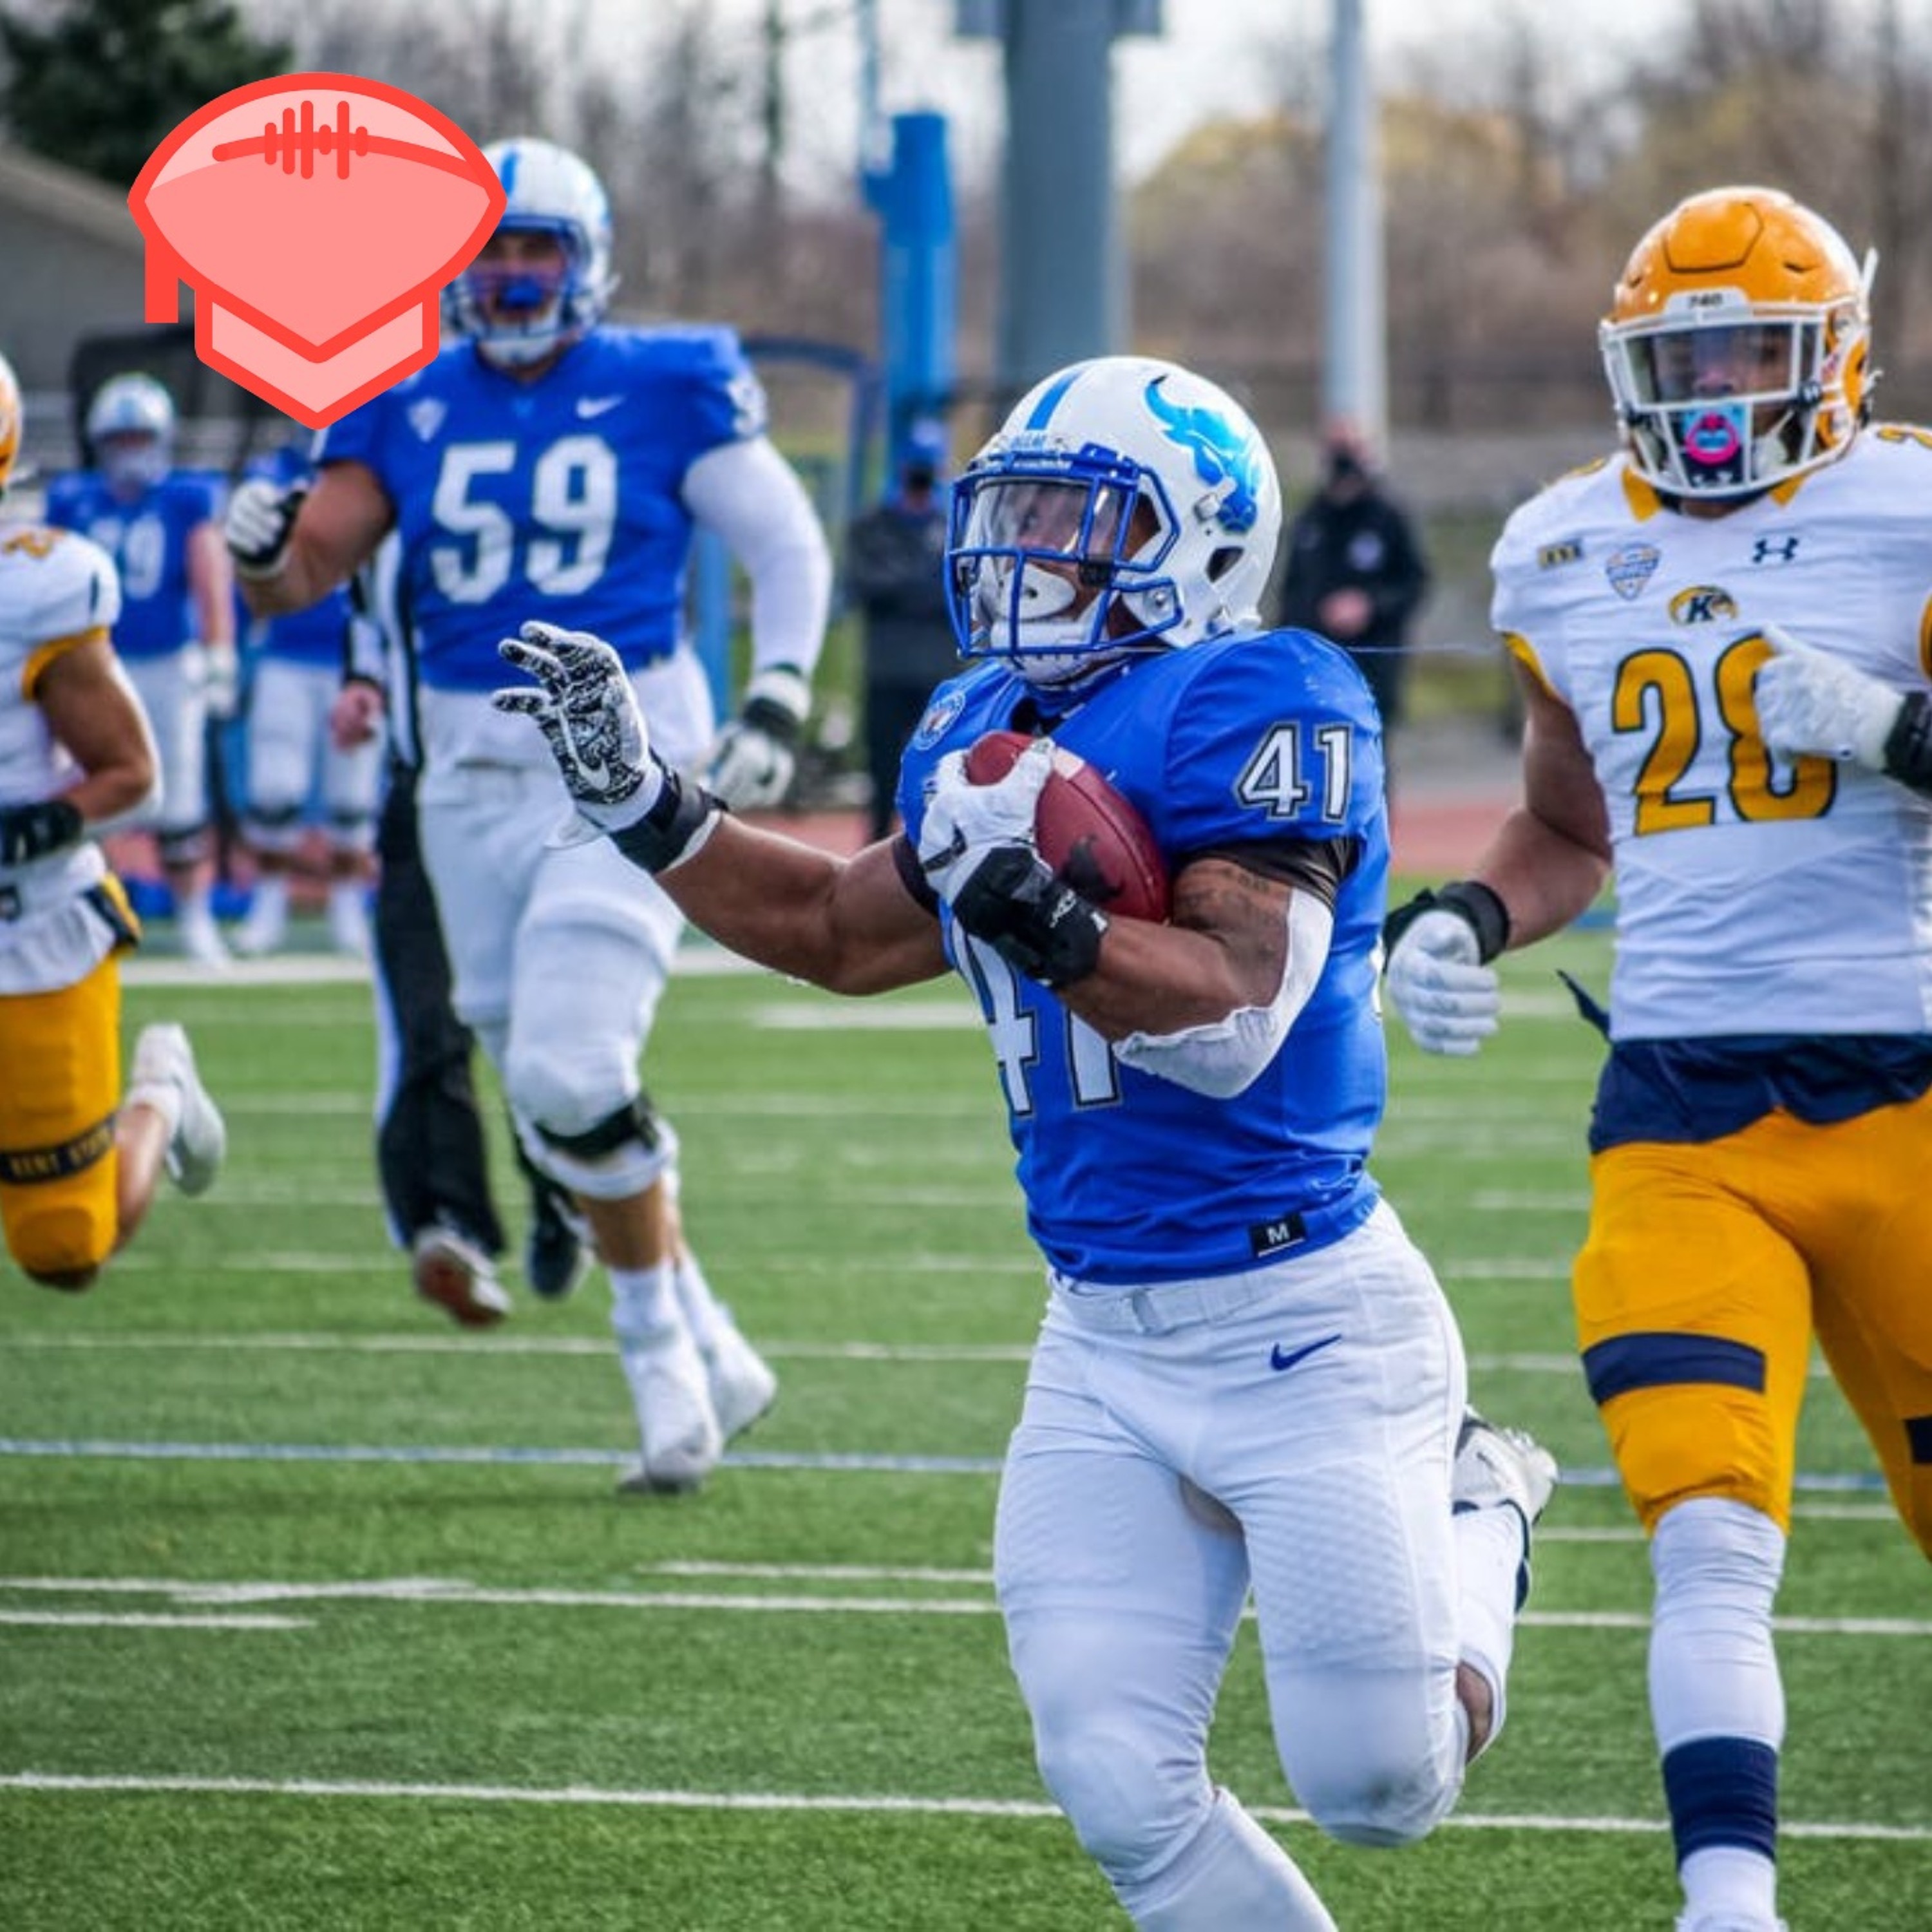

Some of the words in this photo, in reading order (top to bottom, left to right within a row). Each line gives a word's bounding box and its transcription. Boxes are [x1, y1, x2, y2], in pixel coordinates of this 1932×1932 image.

[430, 435, 618, 604] 59
[1233, 721, 1354, 826] 41
[1266, 1222, 1291, 1245] M
